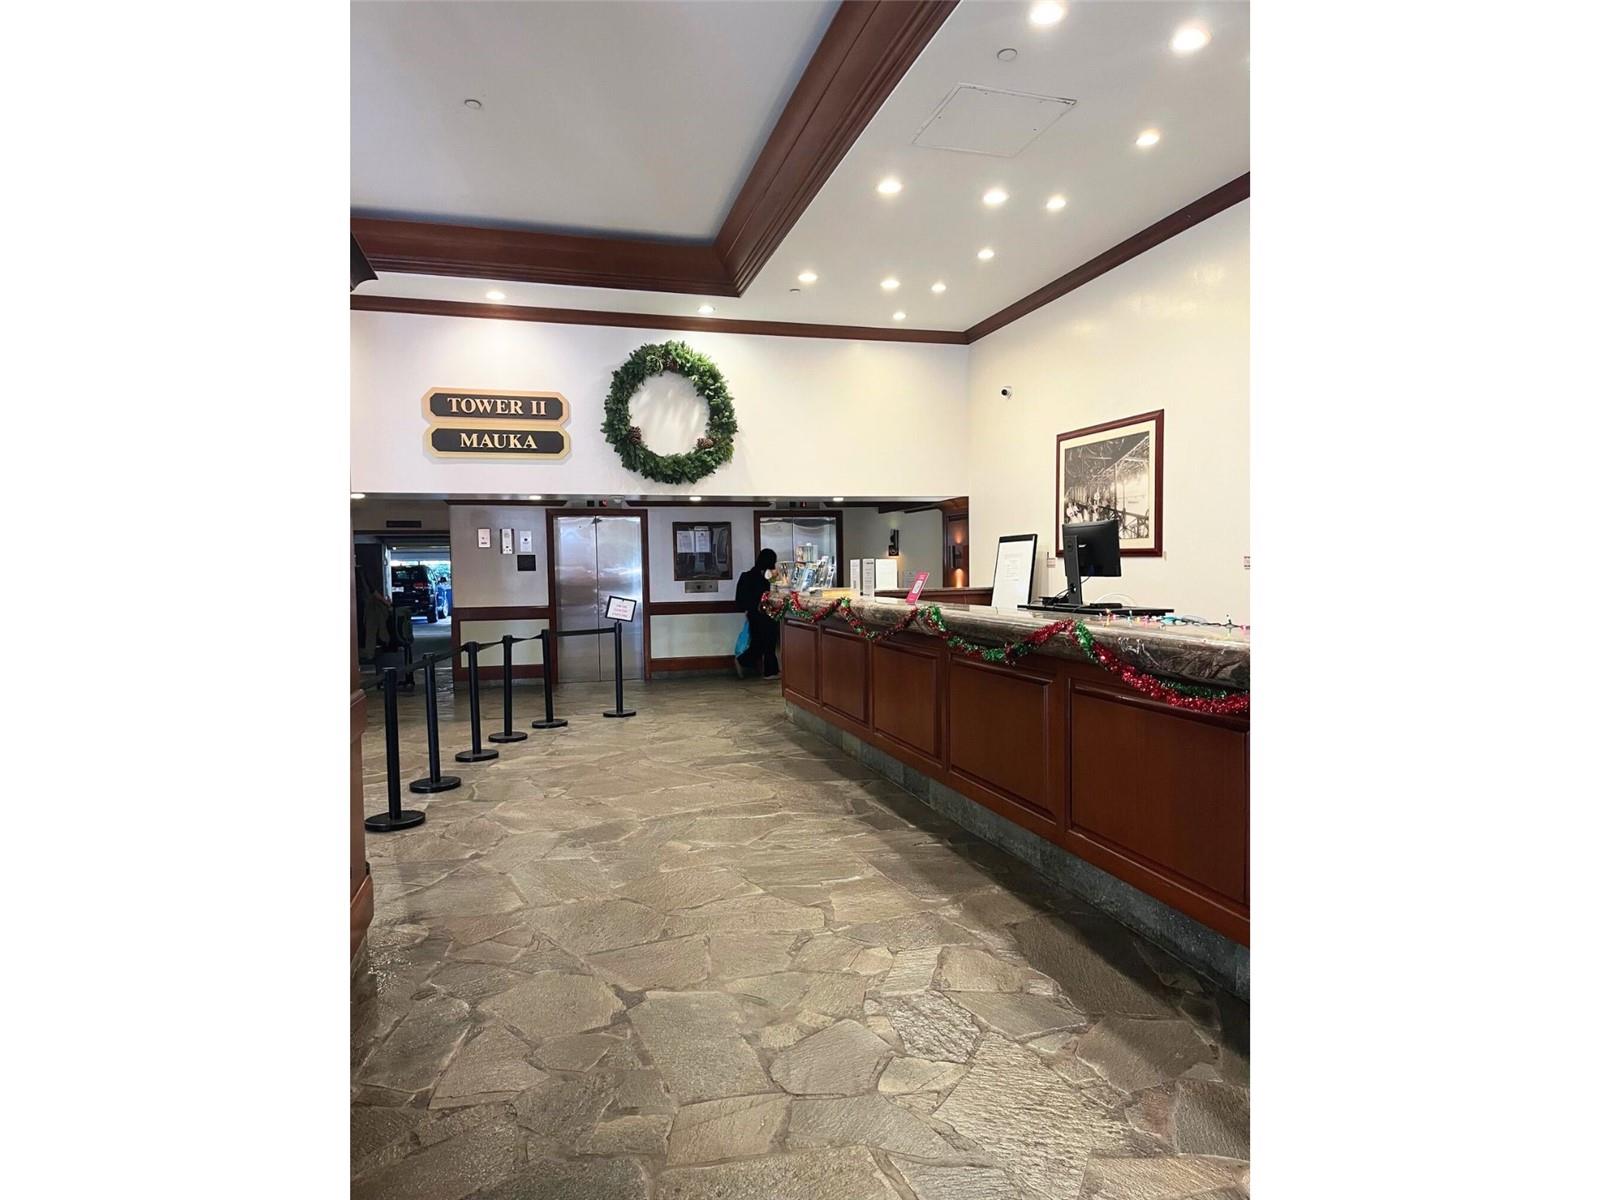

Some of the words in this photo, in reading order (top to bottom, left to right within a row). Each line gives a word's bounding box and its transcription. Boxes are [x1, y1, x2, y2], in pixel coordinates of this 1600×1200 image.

[447, 397, 524, 415] TOWER
[530, 400, 546, 415] II
[459, 432, 537, 449] MAUKA
